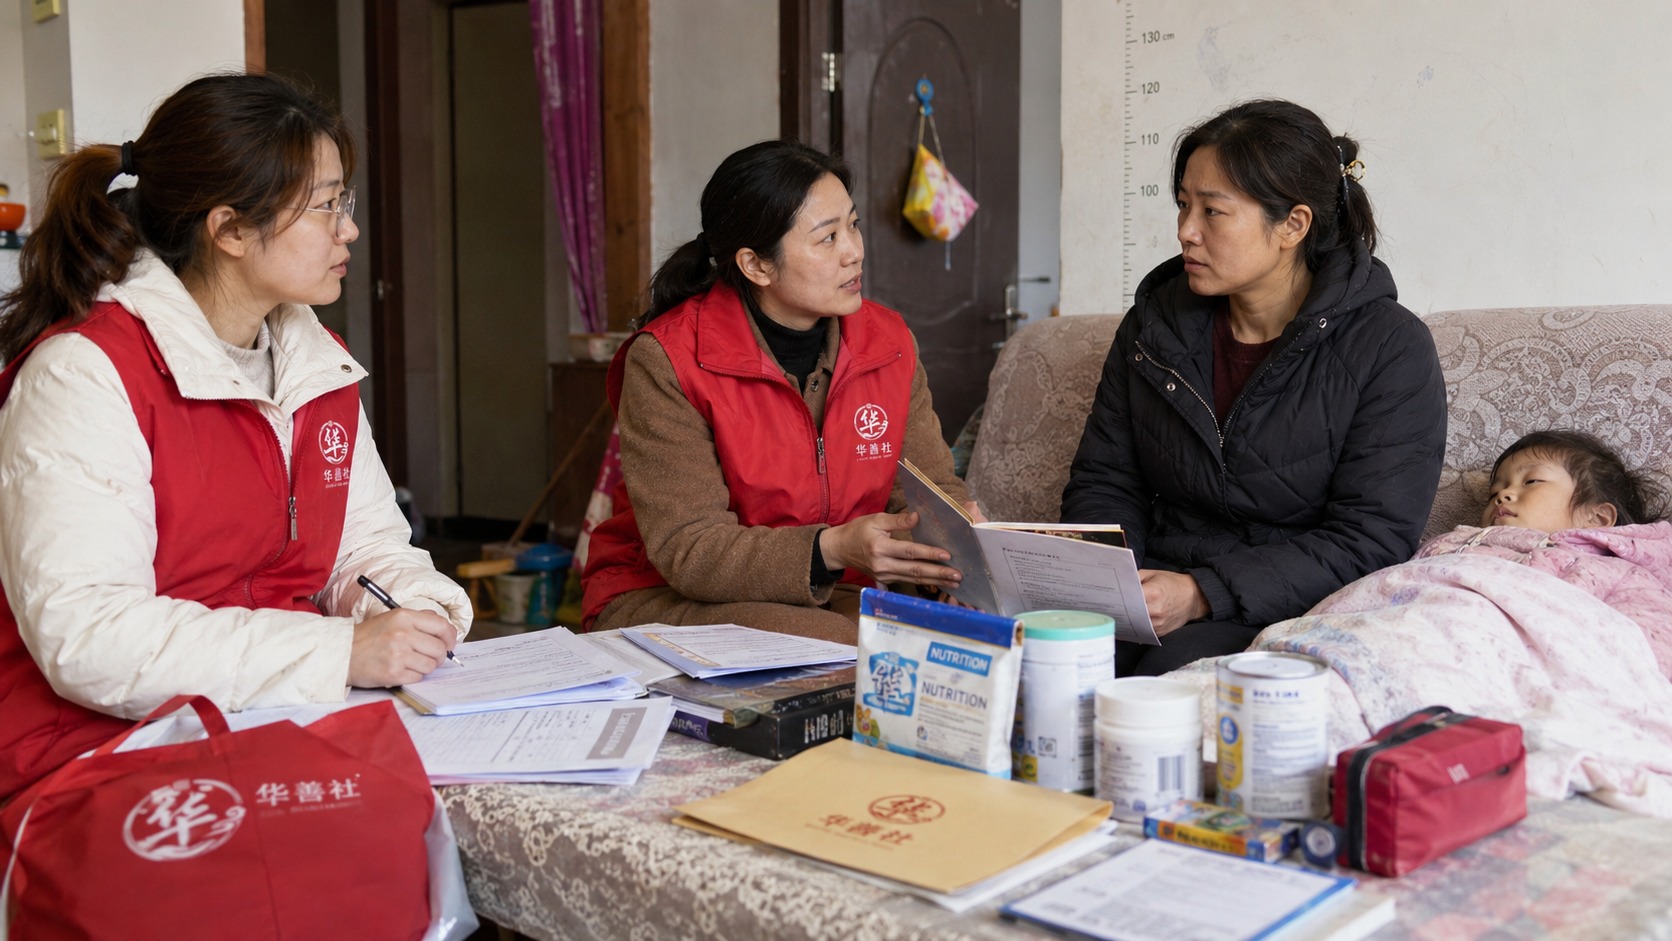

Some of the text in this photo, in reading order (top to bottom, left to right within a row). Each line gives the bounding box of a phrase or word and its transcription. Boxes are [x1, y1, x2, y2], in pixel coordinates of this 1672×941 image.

[1142, 30, 1175, 44] 130 cm
[1142, 81, 1160, 95] 120
[1141, 132, 1159, 145] 110
[1140, 184, 1159, 197] 100
[930, 646, 988, 672] NUTRITION
[921, 681, 987, 710] NUTRITION
[256, 778, 361, 806] 华善社
